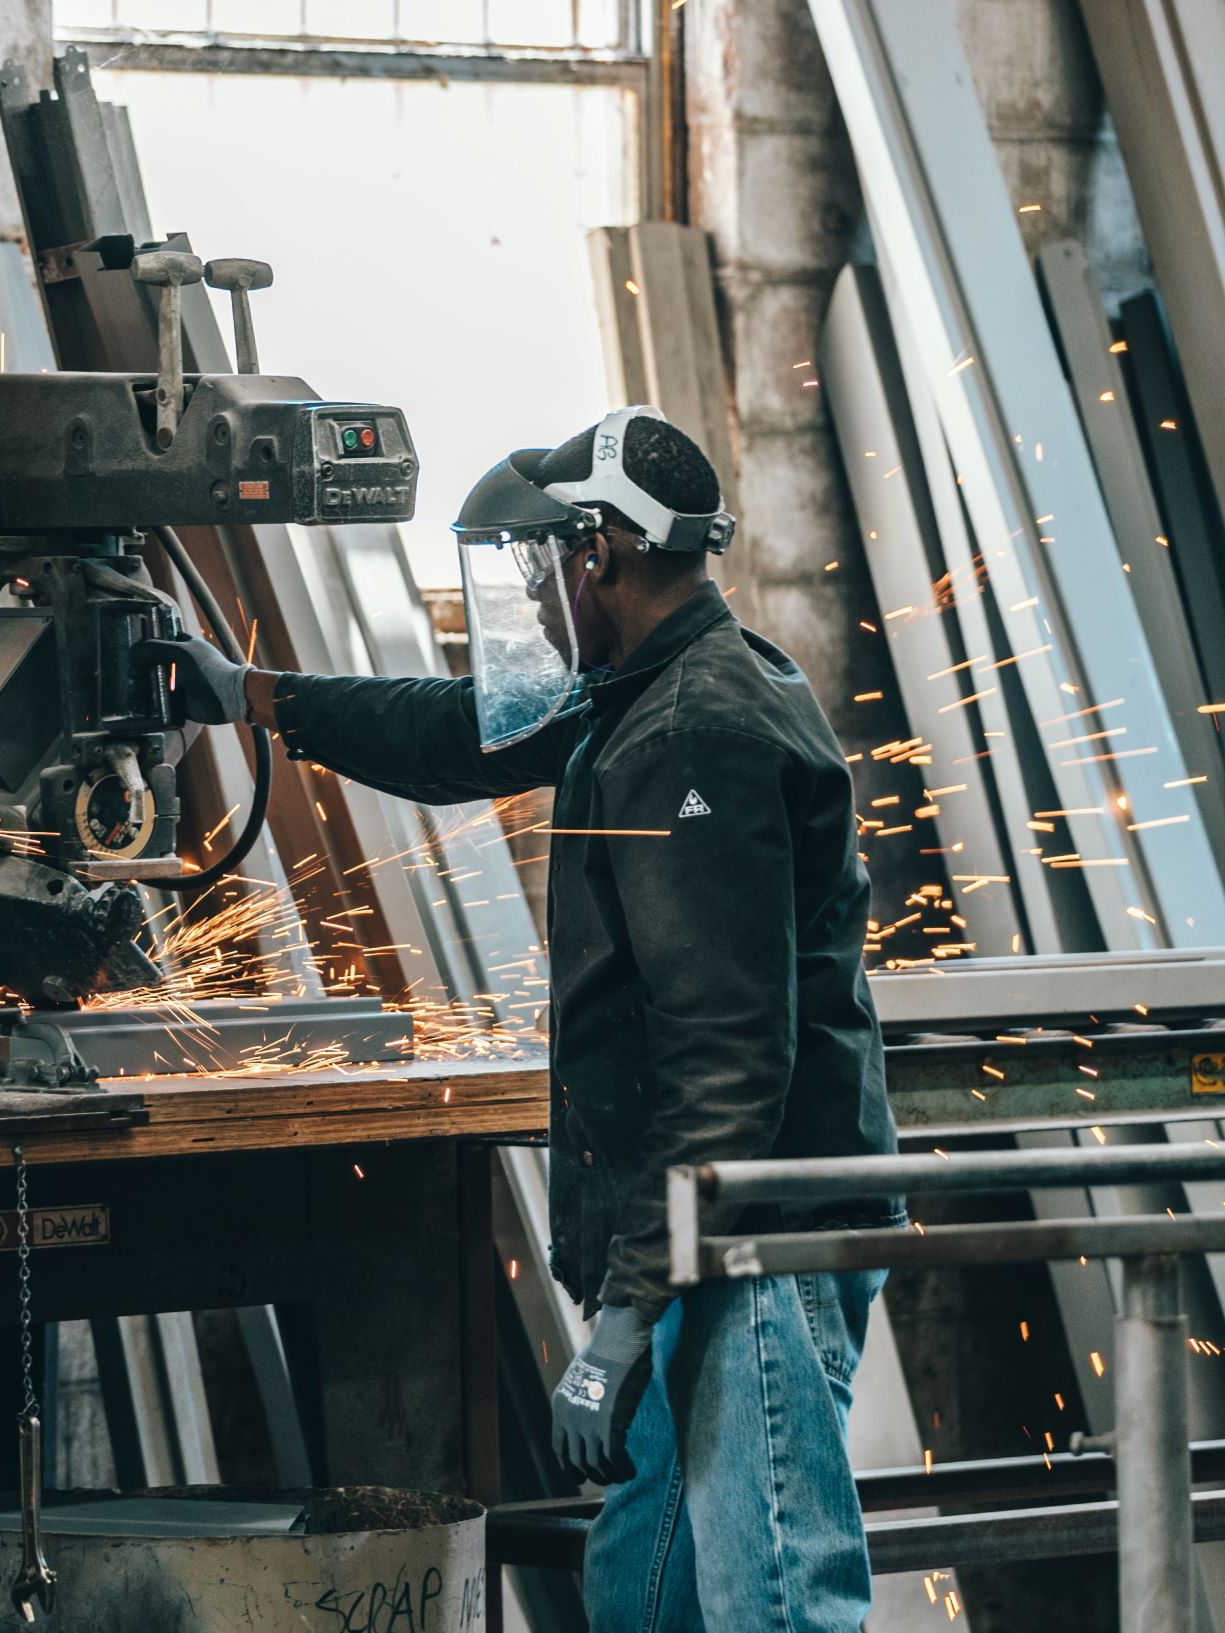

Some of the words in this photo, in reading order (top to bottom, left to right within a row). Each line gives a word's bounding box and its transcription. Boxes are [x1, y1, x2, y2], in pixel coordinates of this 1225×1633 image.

[685, 804, 704, 815] FR
[41, 1211, 101, 1240] DeWalt
[315, 1566, 443, 1633] SCRAP
